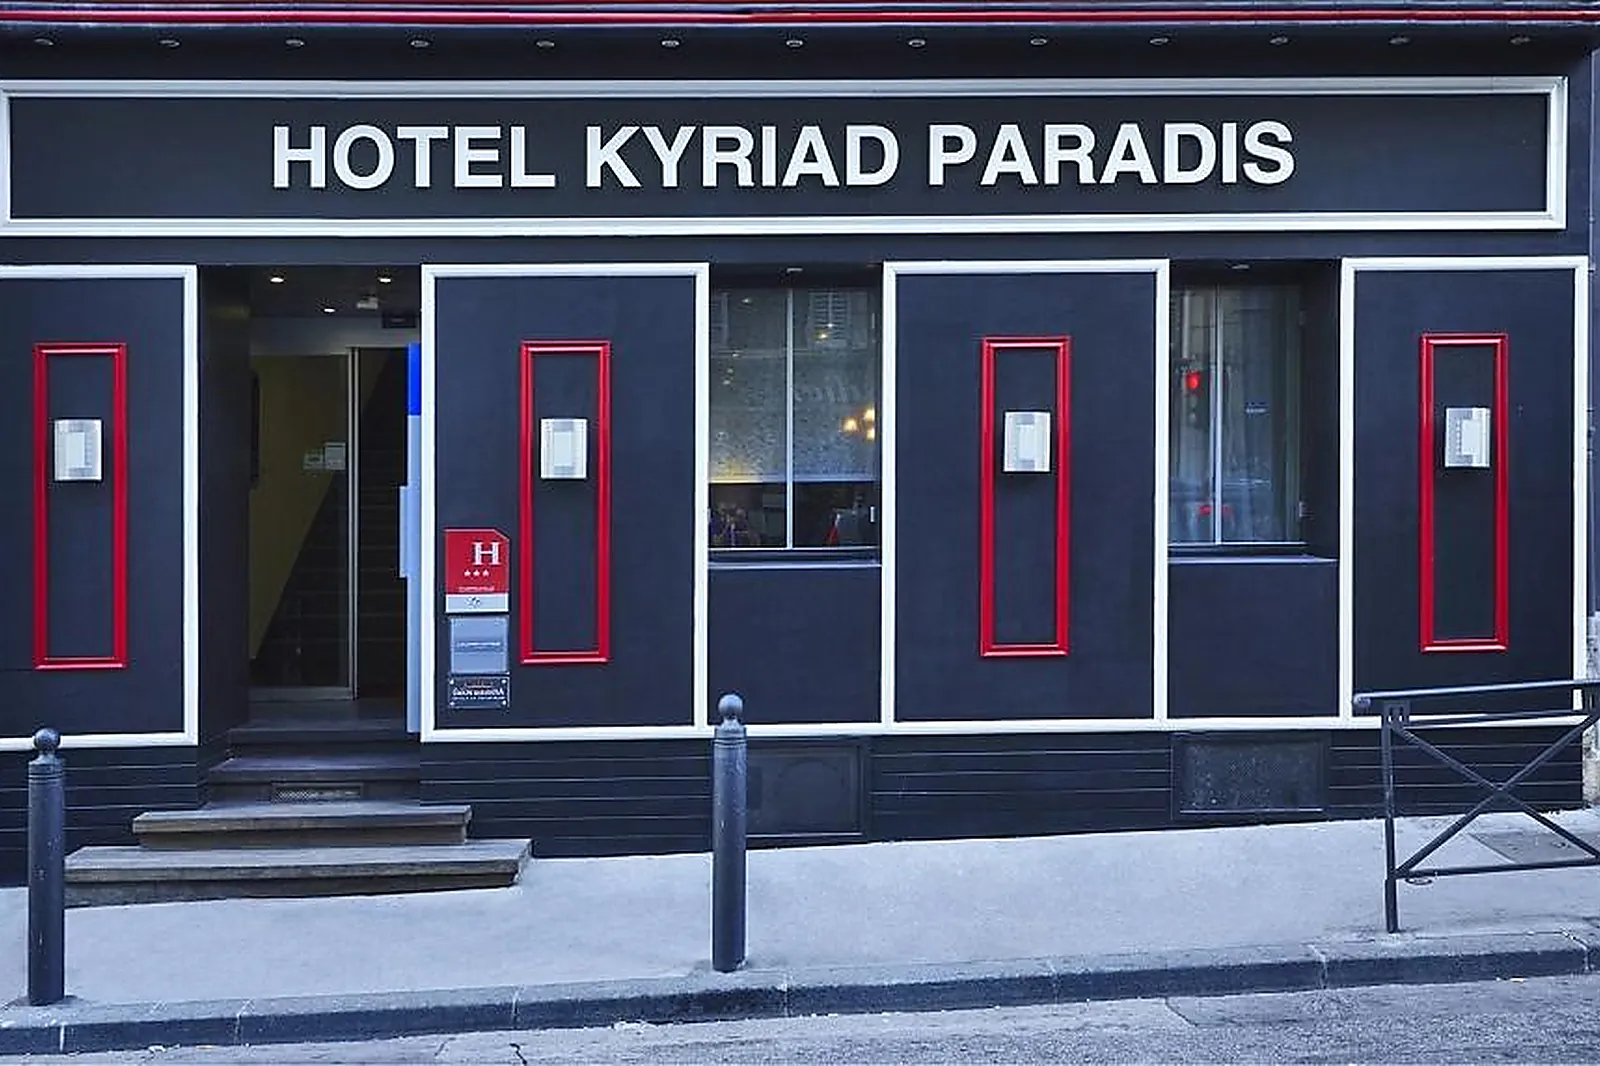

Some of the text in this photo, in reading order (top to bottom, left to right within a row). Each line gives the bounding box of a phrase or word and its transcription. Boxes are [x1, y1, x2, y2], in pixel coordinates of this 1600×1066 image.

[273, 120, 1294, 189] HOTEL KYRIAD PARADIS
[472, 541, 501, 565] H
